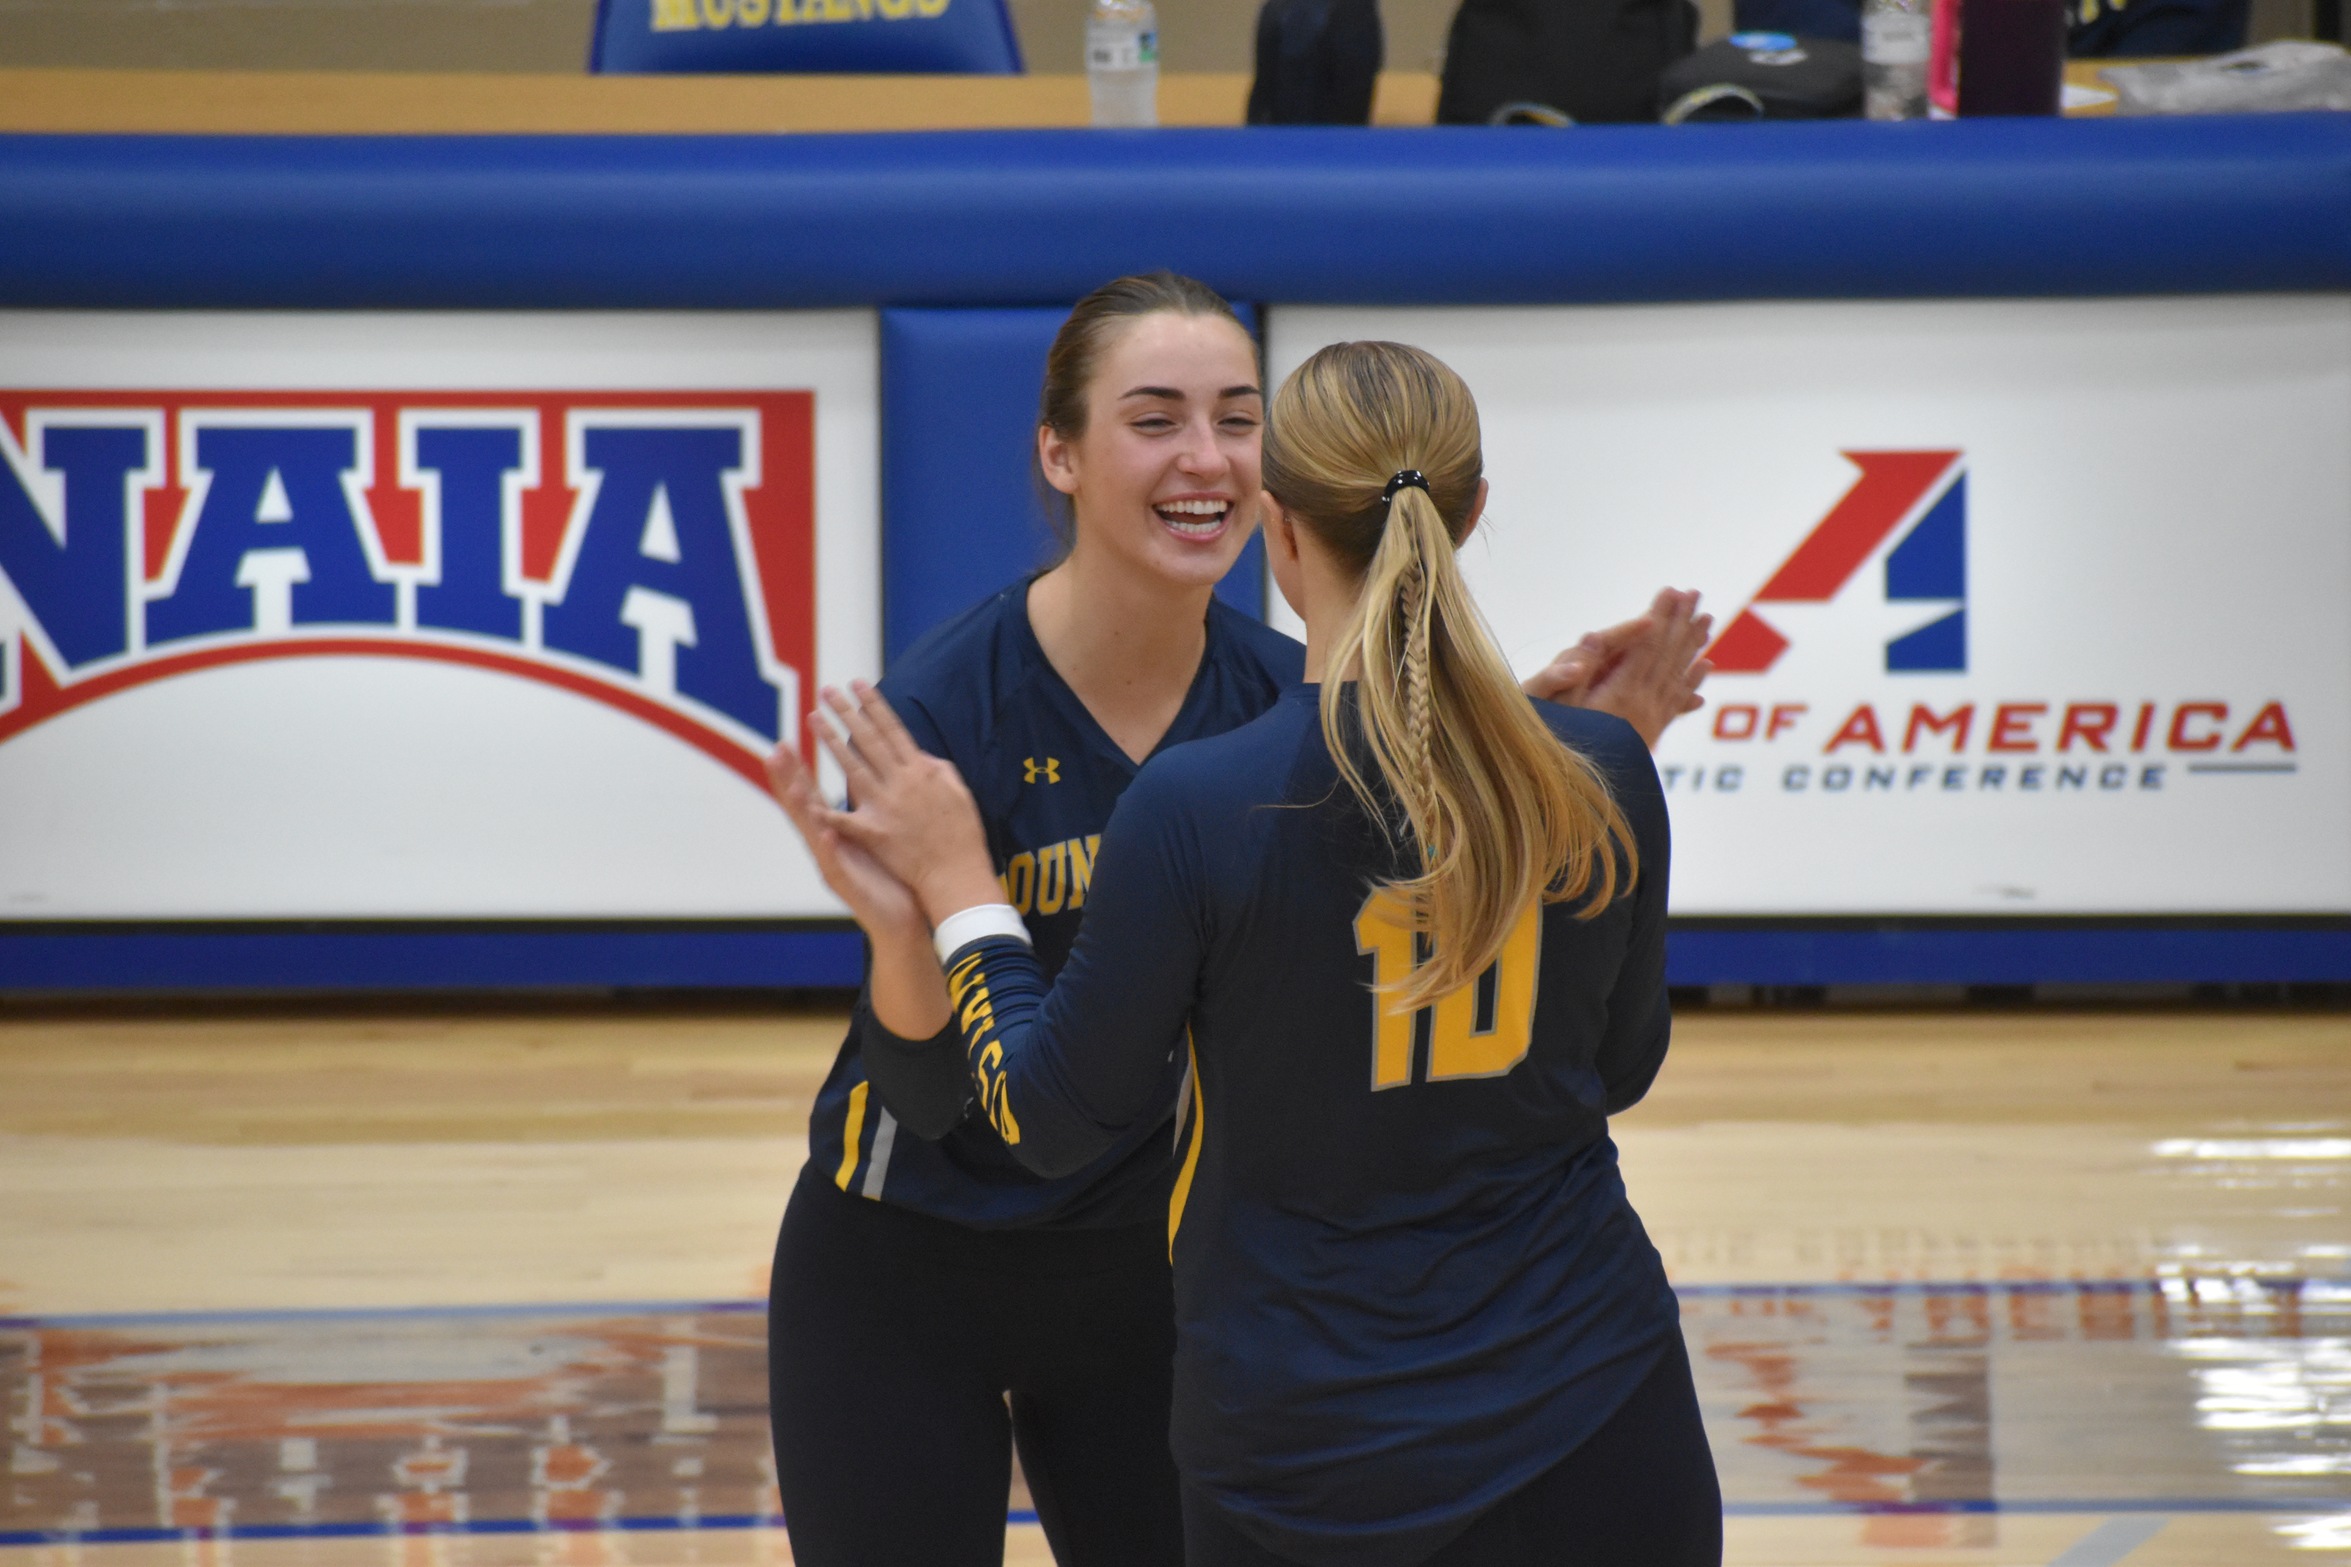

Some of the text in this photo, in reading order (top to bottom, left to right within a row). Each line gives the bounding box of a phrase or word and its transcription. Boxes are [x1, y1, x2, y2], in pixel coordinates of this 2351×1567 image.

[0, 407, 800, 762] NAIA
[1711, 702, 2298, 753] OF AMERICA
[1781, 764, 2166, 791] CONFERENCE
[998, 833, 1102, 917] OUN
[1353, 885, 1543, 1092] 10
